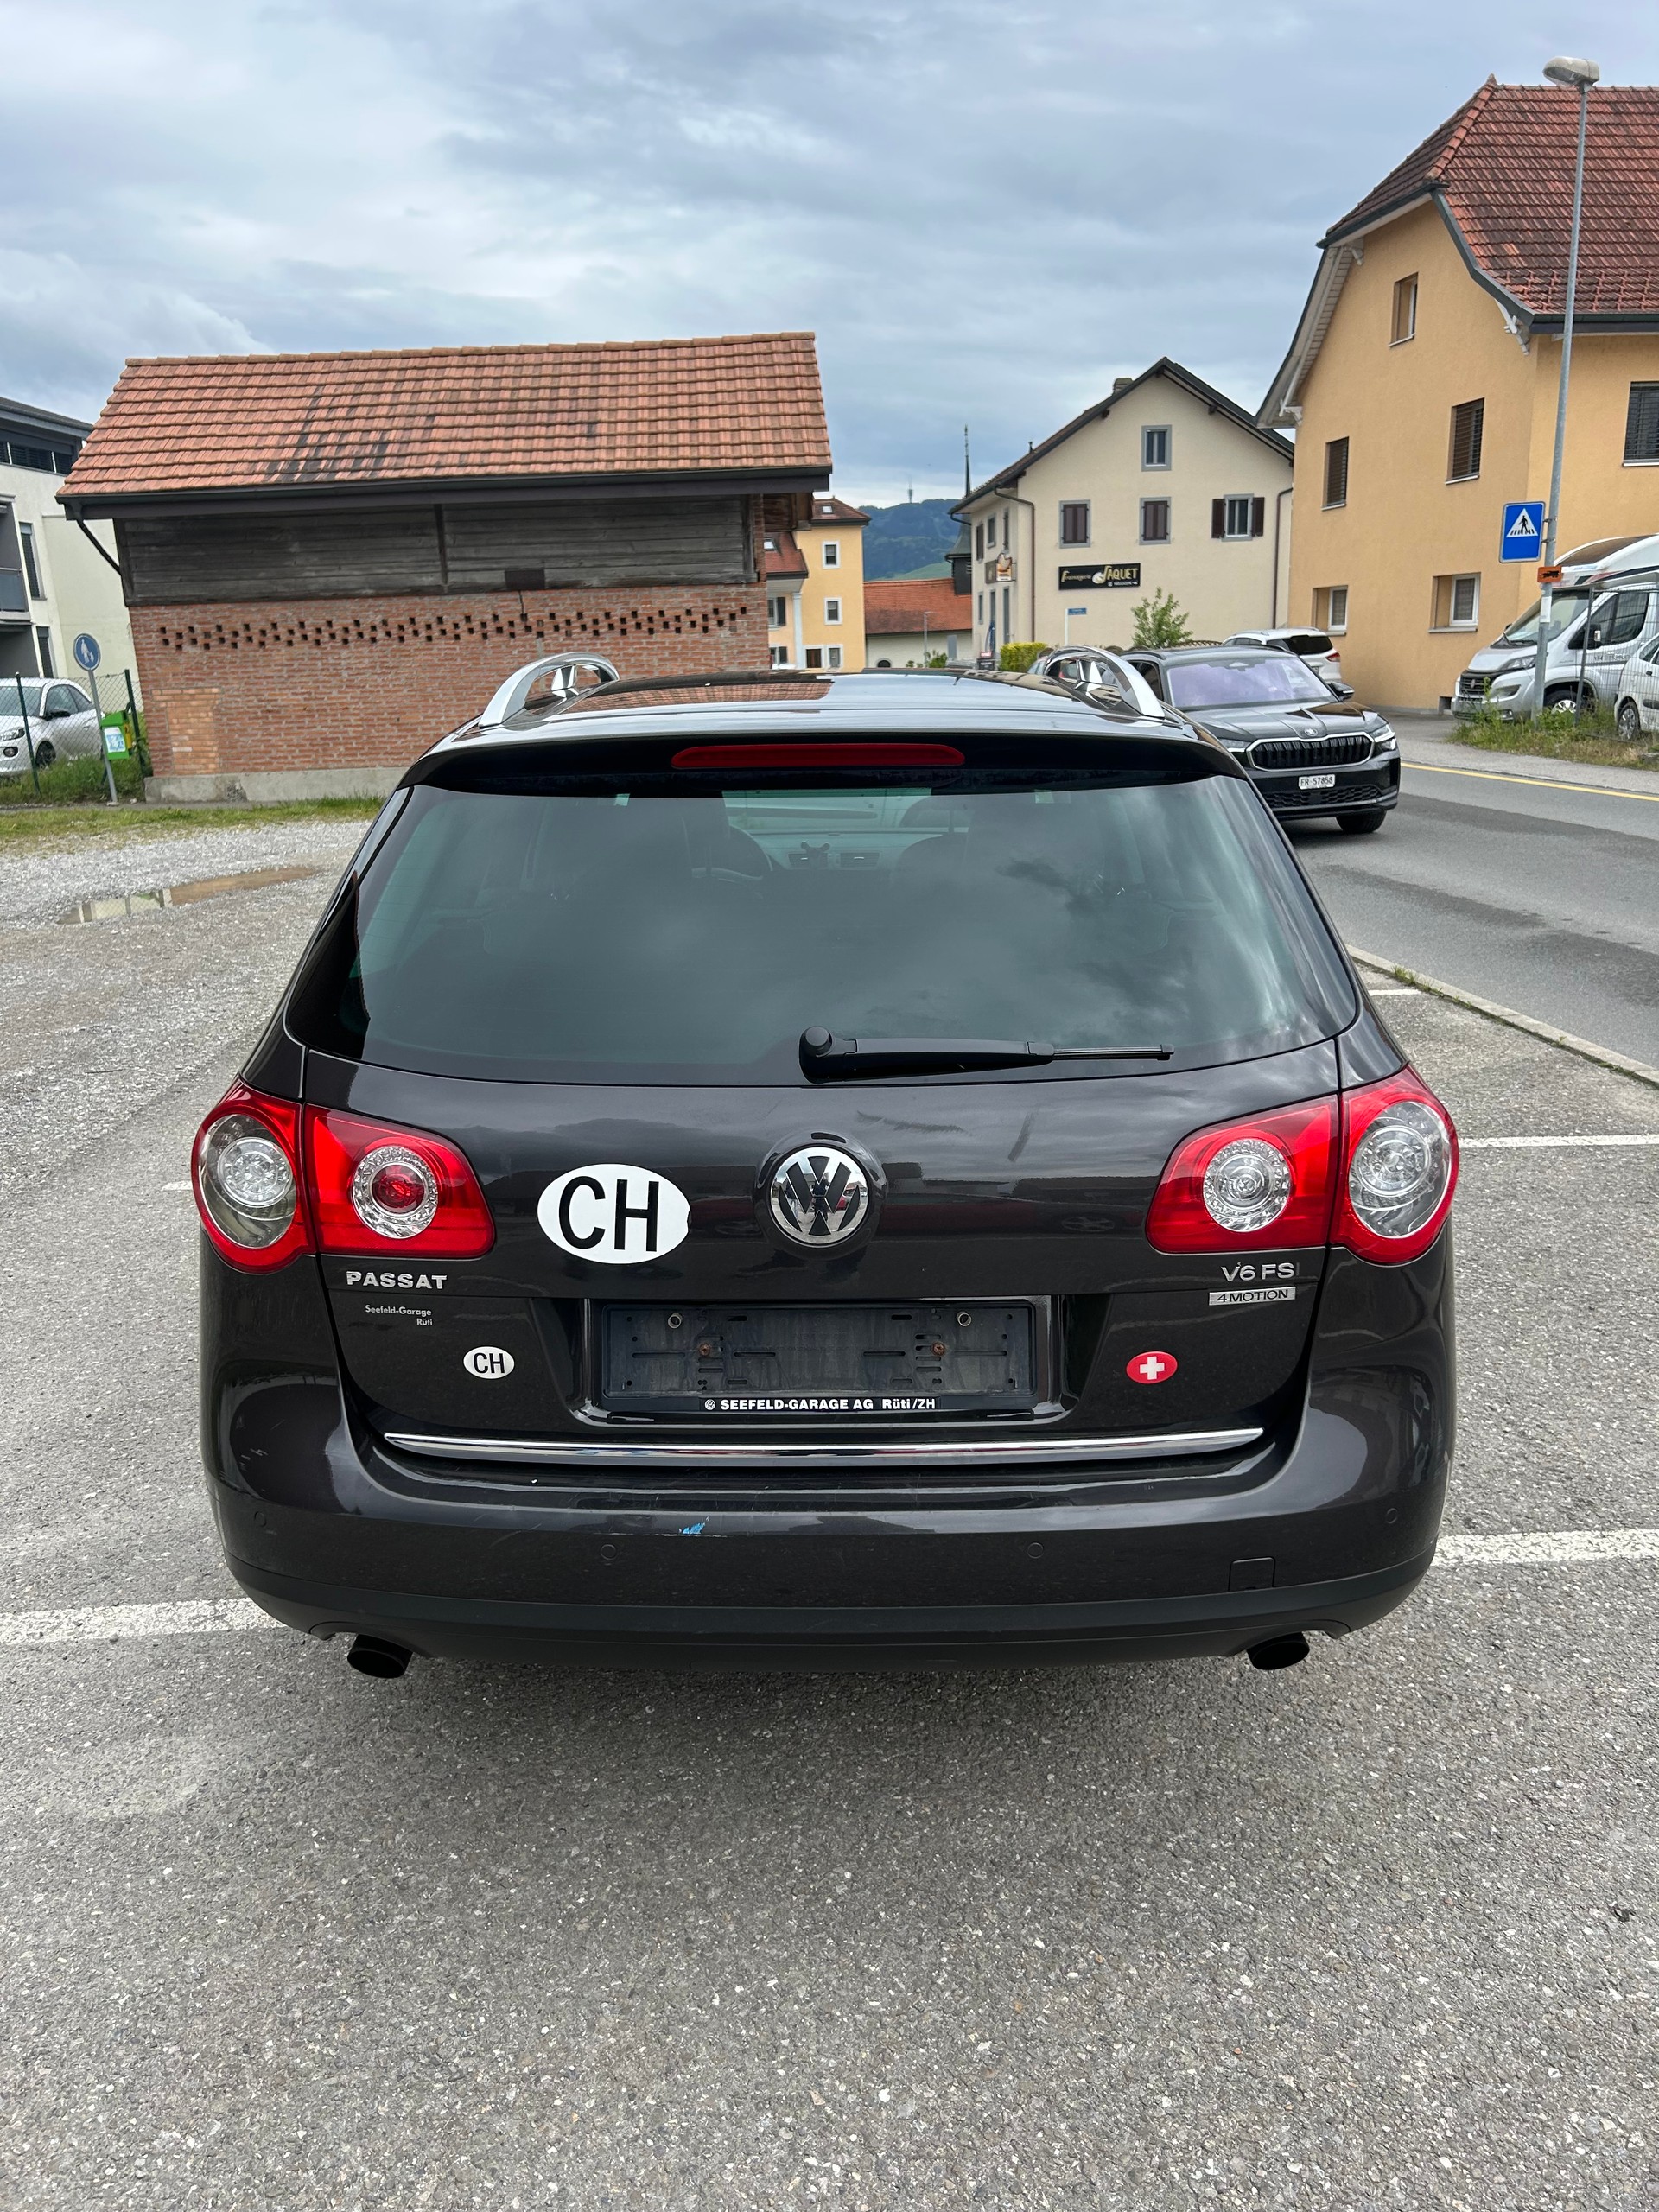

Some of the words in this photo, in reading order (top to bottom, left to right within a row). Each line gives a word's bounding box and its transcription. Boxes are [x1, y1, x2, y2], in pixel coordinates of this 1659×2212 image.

[558, 1175, 659, 1252] CH
[346, 1271, 447, 1289] PASSAT
[1221, 1264, 1256, 1281] V6
[1217, 1289, 1288, 1302] 4MOTION
[365, 1305, 431, 1317] Seefeld-Garage
[473, 1352, 505, 1374] CH
[721, 1399, 849, 1410] SEEFELD-GARAGE
[853, 1399, 874, 1410] AG
